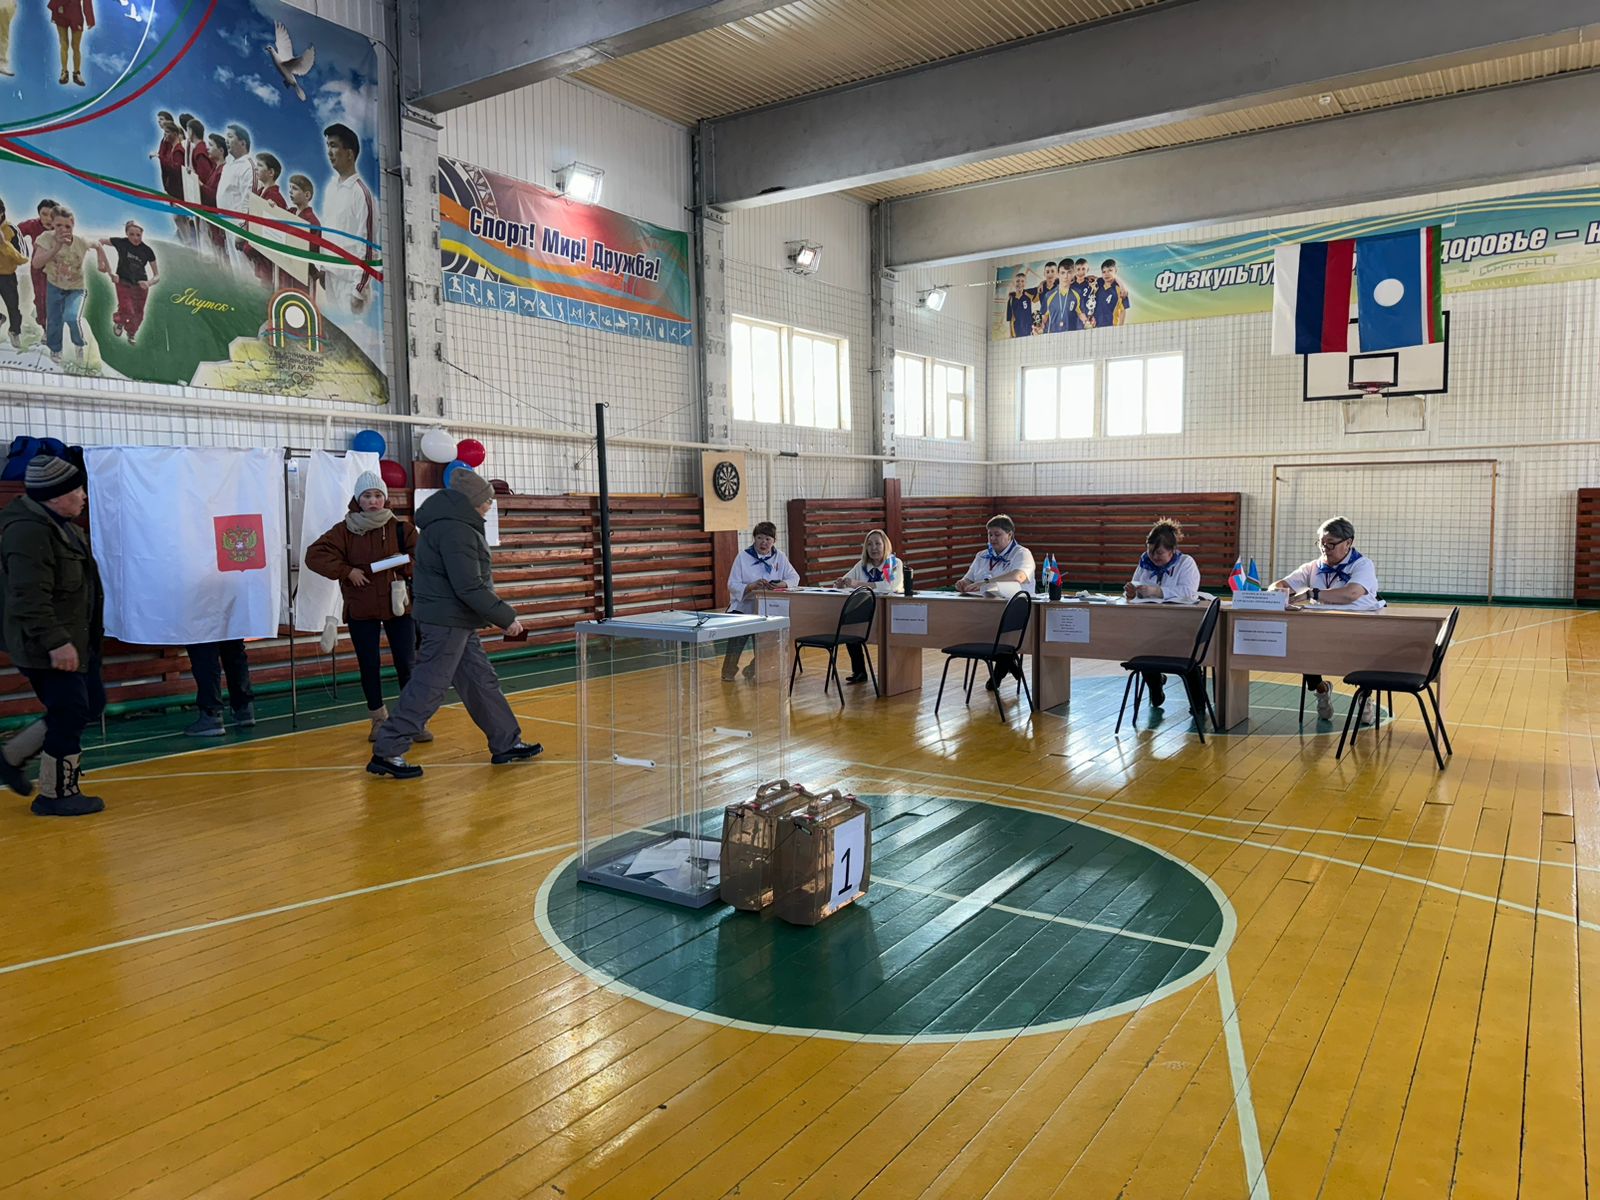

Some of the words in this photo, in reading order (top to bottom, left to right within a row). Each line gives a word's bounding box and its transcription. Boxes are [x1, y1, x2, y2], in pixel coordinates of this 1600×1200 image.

[469, 207, 536, 248] Спорт!
[542, 227, 587, 262] Мир!
[592, 242, 661, 283] Дружба!
[1155, 260, 1275, 293] Физкульту
[1441, 227, 1549, 264] доровье
[170, 287, 230, 315] Якутск
[1106, 294, 1113, 304] 4
[838, 848, 853, 896] 1
